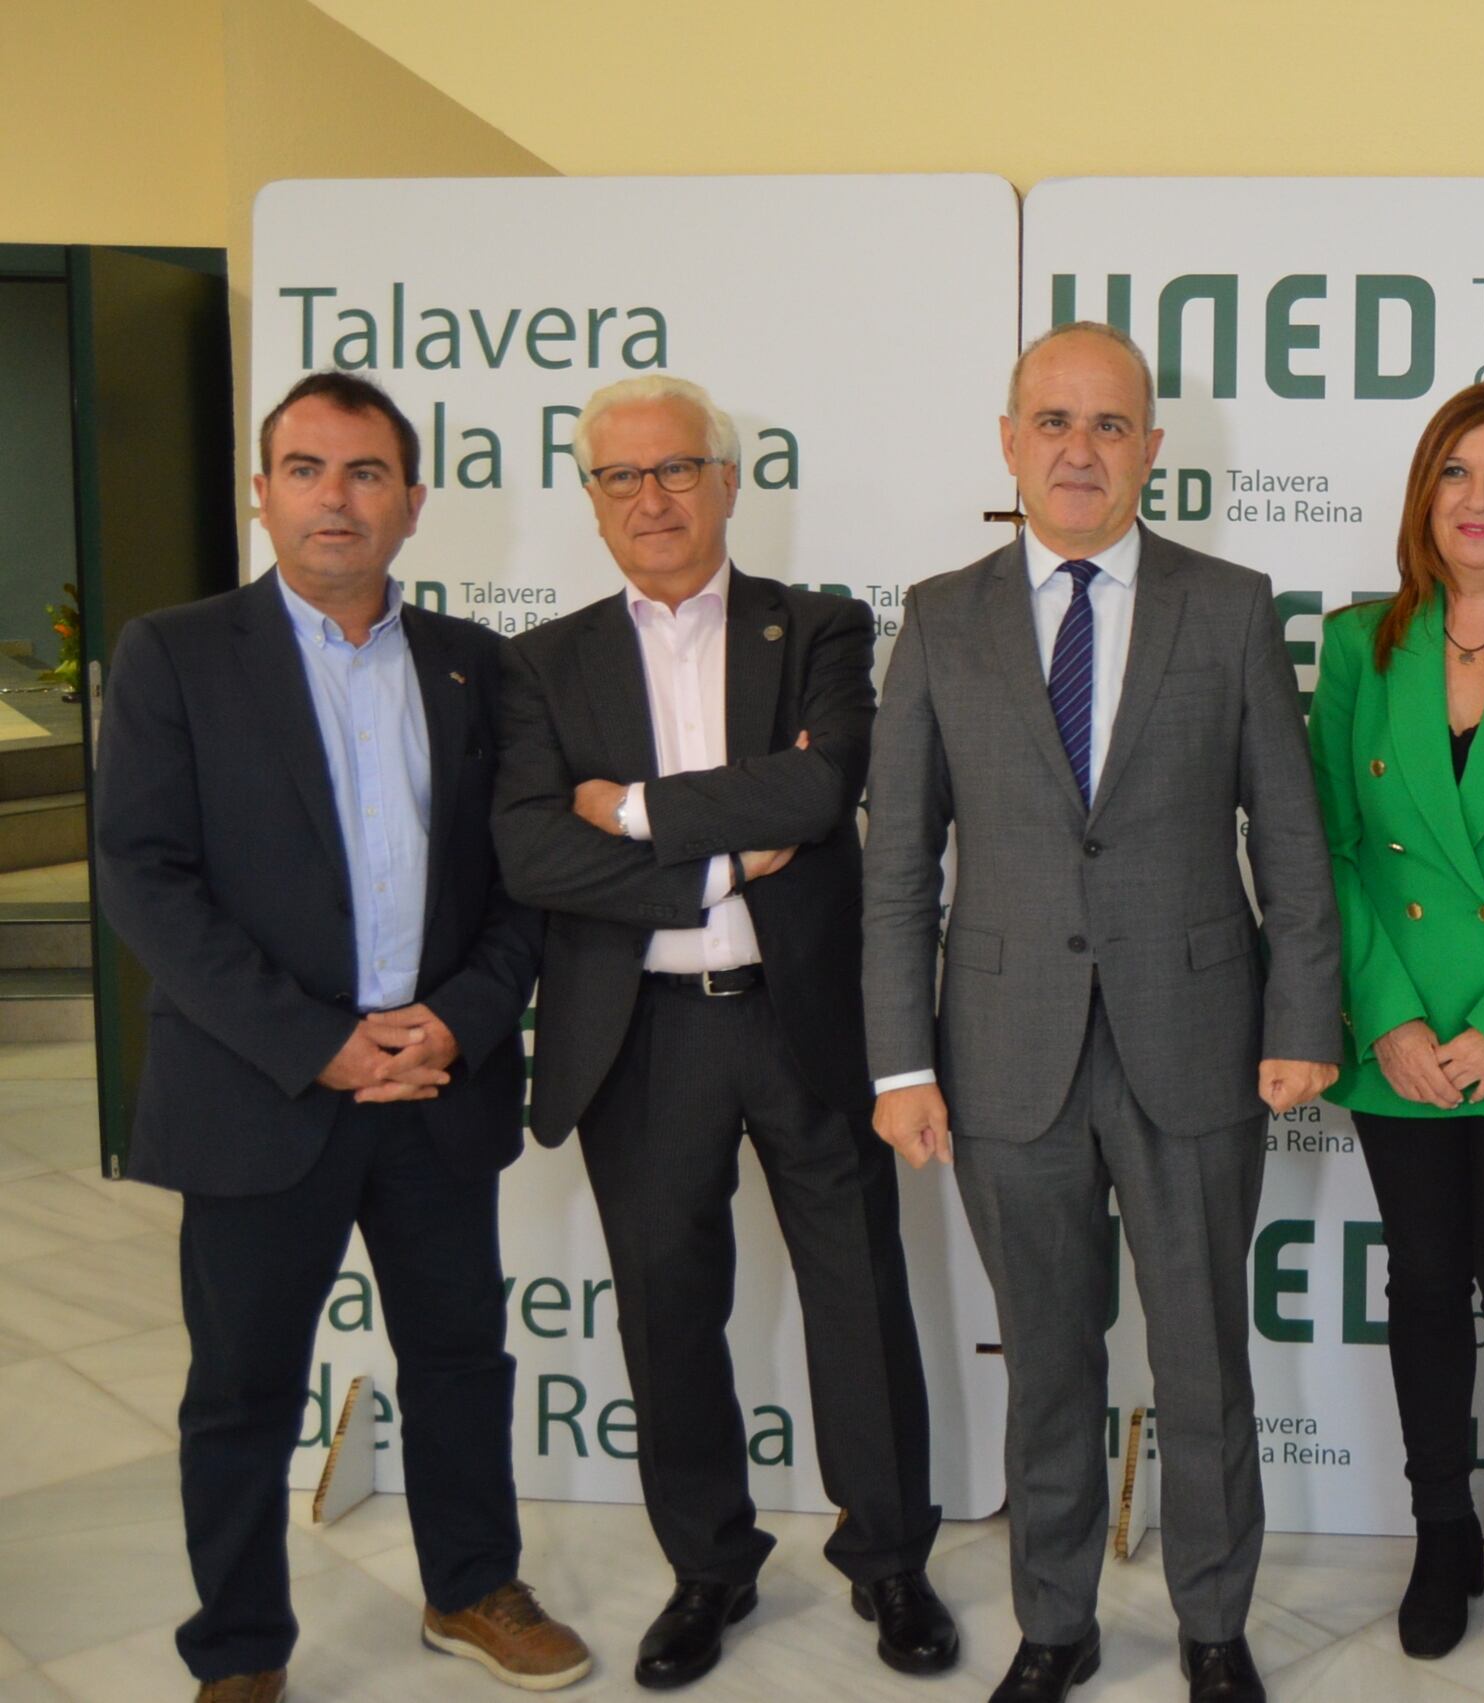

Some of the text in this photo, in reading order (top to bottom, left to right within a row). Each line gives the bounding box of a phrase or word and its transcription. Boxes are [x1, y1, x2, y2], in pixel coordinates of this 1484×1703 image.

[279, 282, 668, 370] Talavera
[434, 402, 502, 489] la
[1226, 469, 1329, 493] Talavera
[1140, 468, 1212, 522] ED
[1227, 499, 1362, 523] de la Reina
[460, 582, 557, 604] Talavera
[498, 611, 516, 633] la
[1270, 1105, 1321, 1122] vera
[1287, 1130, 1355, 1153] Reina
[538, 1373, 794, 1467] Rea
[1254, 1417, 1318, 1435] avera
[1284, 1442, 1351, 1465] Reina
